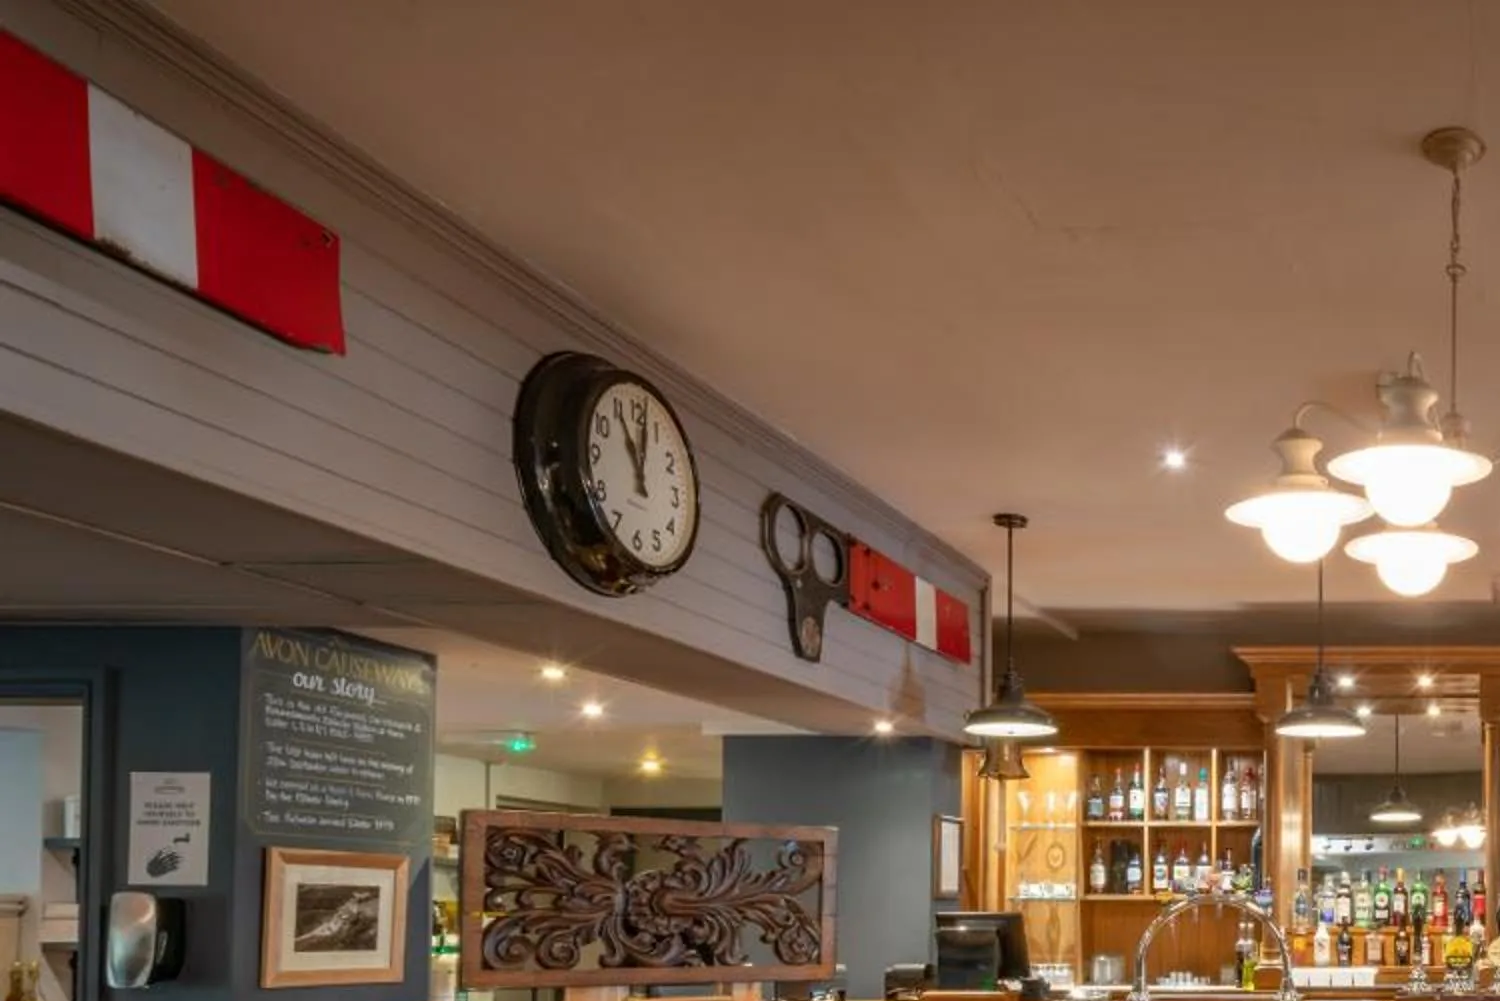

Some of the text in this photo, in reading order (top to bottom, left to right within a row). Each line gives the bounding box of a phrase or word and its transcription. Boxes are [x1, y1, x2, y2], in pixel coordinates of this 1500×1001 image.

[631, 398, 646, 427] 12
[595, 411, 610, 439] 10
[591, 443, 601, 466] 9
[665, 450, 675, 475] 2
[595, 479, 607, 502] 8
[671, 486, 679, 509] 3
[612, 509, 623, 532] 7
[666, 517, 675, 536] 4
[632, 529, 643, 552] 6
[652, 528, 662, 552] 5
[252, 631, 310, 668] AVON
[292, 671, 327, 692] our
